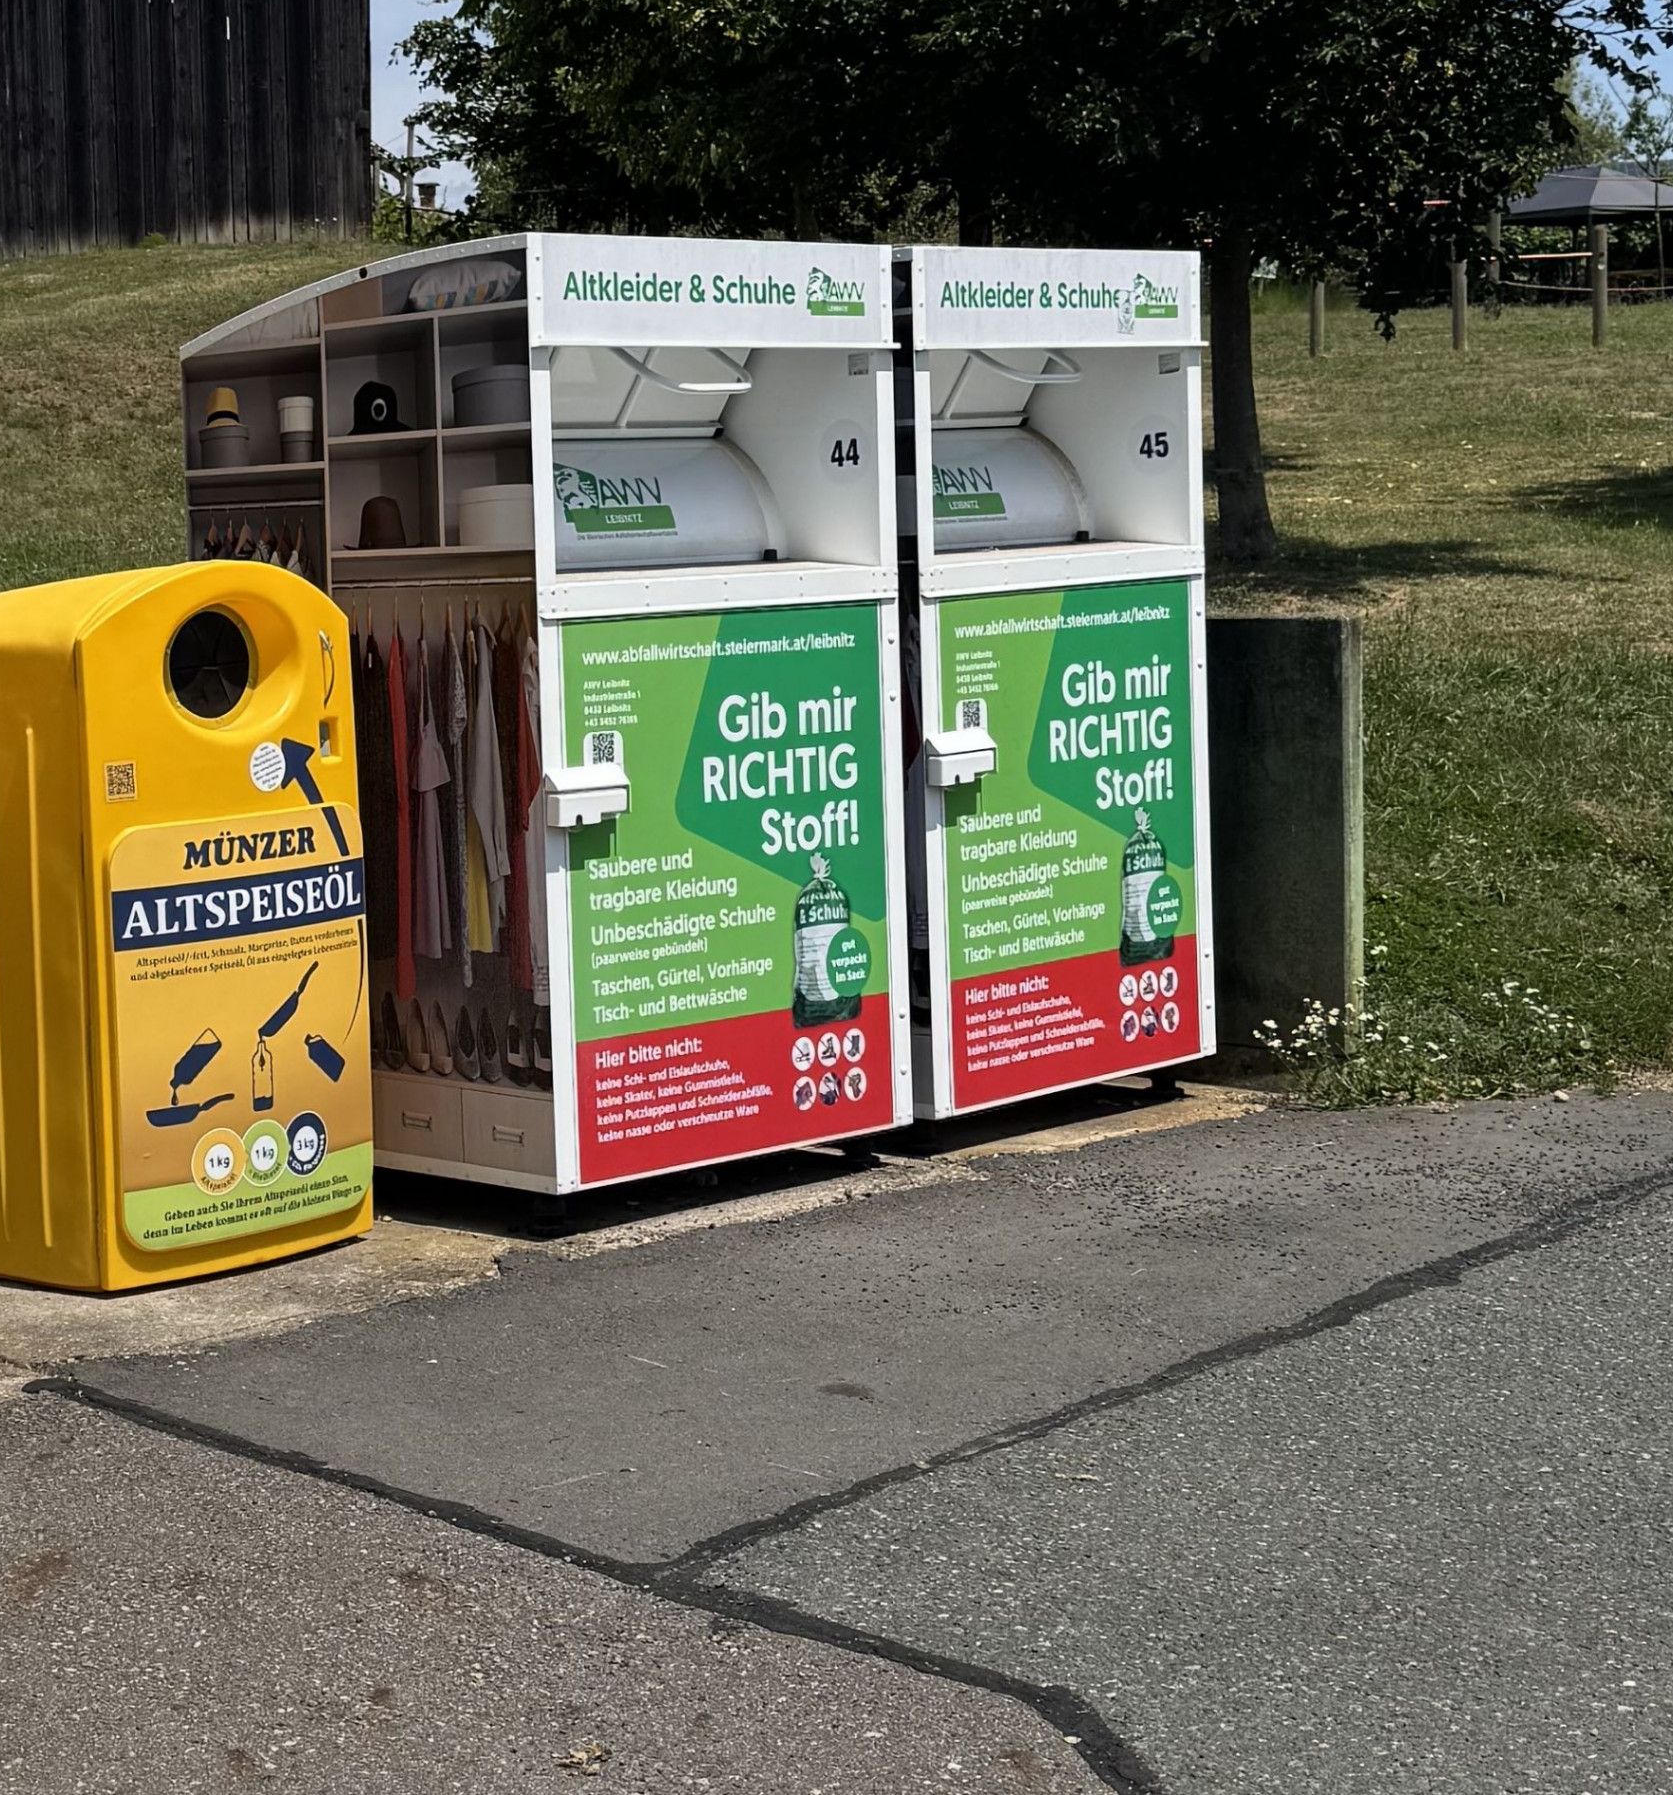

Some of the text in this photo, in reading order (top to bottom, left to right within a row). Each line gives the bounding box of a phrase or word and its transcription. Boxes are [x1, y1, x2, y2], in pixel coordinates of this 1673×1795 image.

[563, 270, 796, 304] Altkleider & Schuhe
[940, 280, 1034, 308] Altkleider
[1039, 282, 1053, 308] &
[830, 438, 860, 467] 44
[1139, 431, 1169, 459] 45
[599, 476, 661, 506] AWV
[940, 466, 993, 493] AWV
[582, 632, 856, 666] www.abfallwirtschaft.steiermark.at/leibnitz
[1061, 654, 1172, 707] Gib mir
[718, 685, 857, 742] Gib mir
[1049, 706, 1173, 763] RICHTIG
[702, 742, 858, 803] RICHTIG
[1095, 758, 1174, 810] Stoff!
[761, 799, 860, 855] Stoff!
[960, 803, 1042, 834] Saubere und
[183, 826, 316, 870] MÜNZER
[960, 829, 1077, 862] tragbare Kleidung
[588, 848, 693, 880] Saubere und
[961, 863, 1060, 893] Unbeschädigte
[1062, 853, 1108, 876] Schuhe
[122, 866, 361, 940] ALTSPEISEÖL
[589, 876, 738, 912] tragbare Kleidung
[591, 903, 777, 946] Unbeschädigte Schuhe
[963, 902, 1105, 940] Taschen, Gürtel, Vorhänge
[591, 937, 708, 969] (paarweise gebündelt)
[963, 928, 1085, 964] Tisch- und Bettwäsche
[592, 957, 773, 997] Taschen, Gürtel, Vorhänge
[965, 975, 1049, 1005] Hier bitte nicht:
[593, 986, 748, 1025] Tisch- und Bettwäsche
[595, 1037, 703, 1070] Hier bitte nicht:
[595, 1076, 623, 1092] keine
[624, 1072, 646, 1086] Schi-
[648, 1068, 667, 1083] und
[596, 1093, 623, 1109] keine
[657, 1084, 683, 1098] keine
[597, 1110, 624, 1126] keine
[625, 1103, 677, 1122] Putzlappen
[678, 1097, 697, 1112] und
[597, 1103, 759, 1143] keine nasse oder Ware
[263, 1146, 275, 1160] kg
[304, 1138, 315, 1150] kg
[209, 1156, 230, 1169] 1 kg
[164, 1209, 195, 1222] Geben
[196, 1203, 219, 1216] auch
[220, 1201, 234, 1212] Sie
[236, 1196, 262, 1209] Ihrem
[143, 1229, 169, 1240] denn
[185, 1219, 214, 1232] Leben
[216, 1213, 248, 1227] kommt
